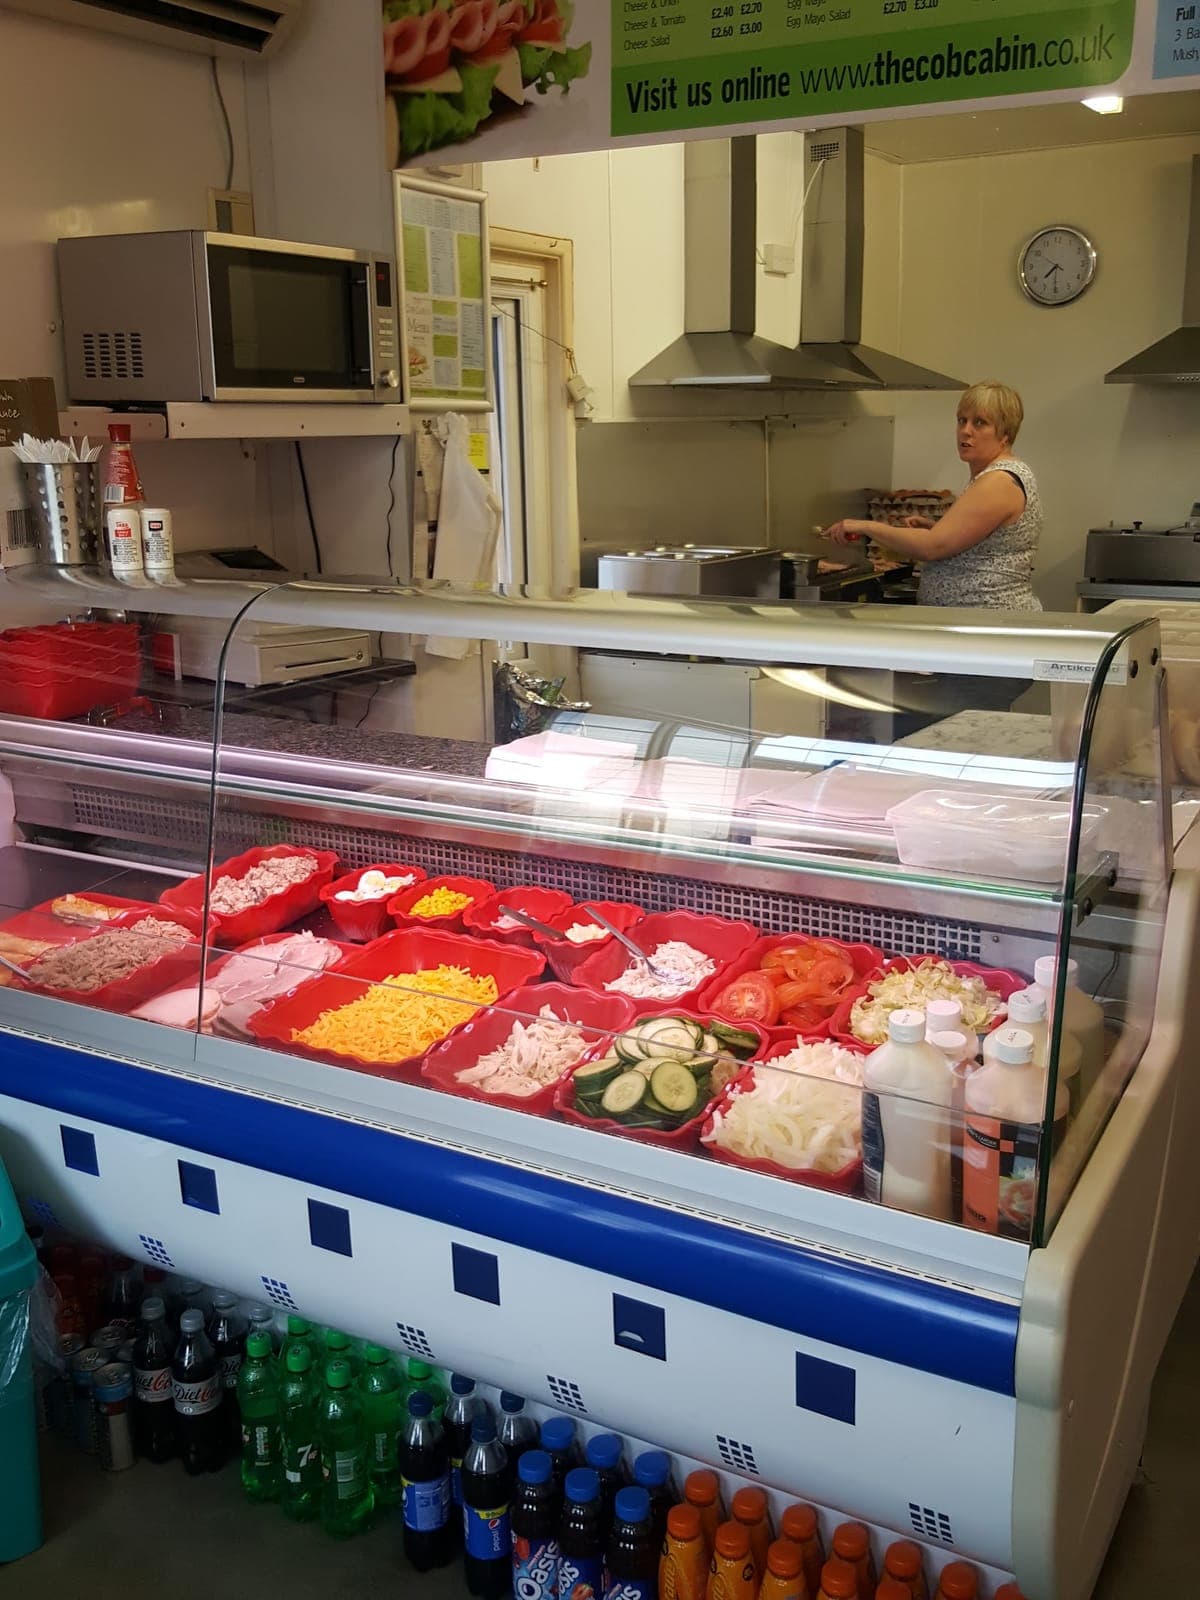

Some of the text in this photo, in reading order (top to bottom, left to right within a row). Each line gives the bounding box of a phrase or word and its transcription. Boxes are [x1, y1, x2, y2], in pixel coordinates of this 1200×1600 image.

[624, 1, 648, 12] Cheese
[624, 20, 648, 31] Cheese
[661, 15, 686, 26] Tomato
[711, 6, 734, 19] £2.40
[741, 2, 762, 15] £2.70
[786, 16, 801, 29] Egg
[804, 13, 826, 26] Mayo
[829, 8, 851, 21] Salad
[883, 0, 907, 14] £2.70
[1176, 6, 1196, 21] Full
[624, 22, 762, 51] Cheese Salad £2.60 £3.00
[1174, 29, 1182, 42] 3
[626, 23, 1116, 113] Visit us online www.thecobcabin.co.uk
[174, 1384, 201, 1403] Diet
[517, 1540, 560, 1600] Oasis
